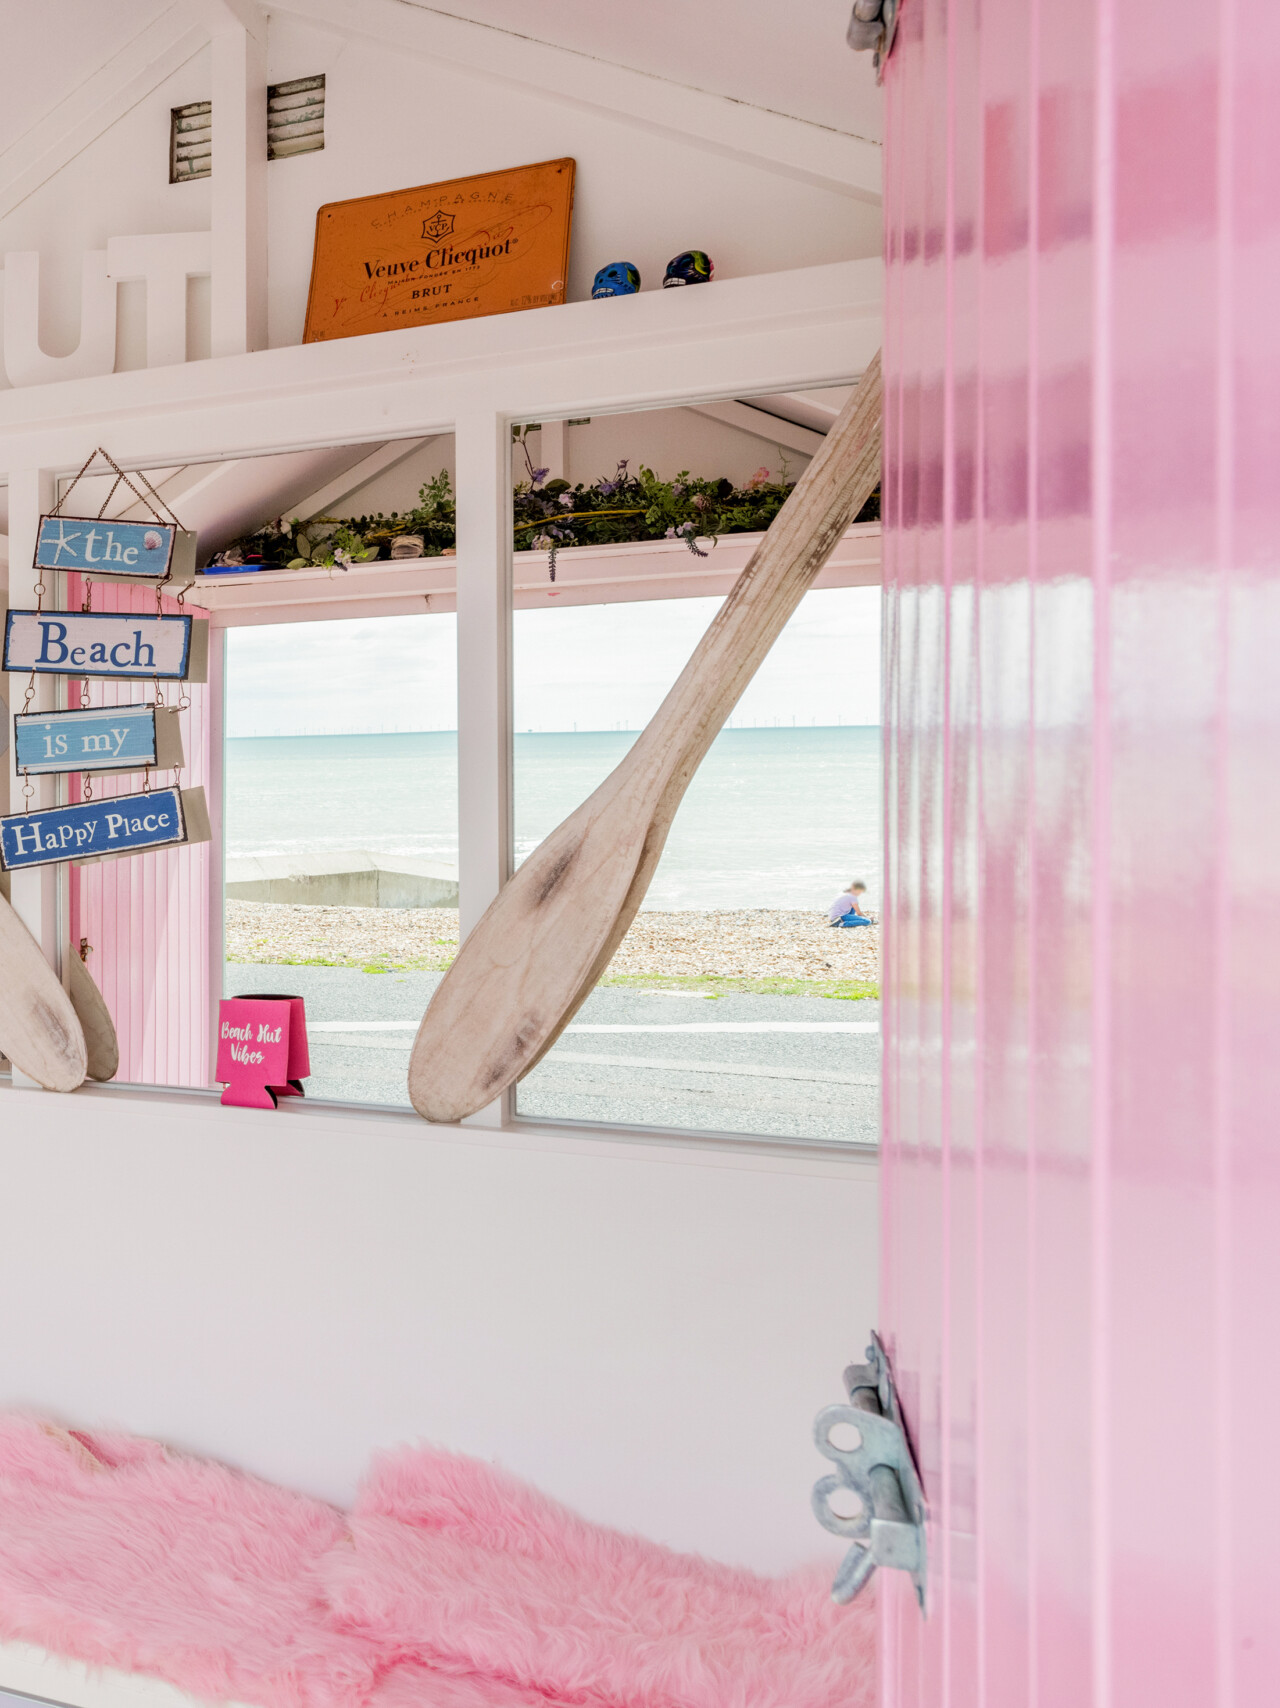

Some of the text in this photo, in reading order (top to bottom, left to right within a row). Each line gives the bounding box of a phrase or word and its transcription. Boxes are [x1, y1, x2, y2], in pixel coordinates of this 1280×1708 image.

[370, 192, 514, 228] CHAMPAGNE
[363, 258, 419, 280] Veuve
[411, 283, 453, 299] BRUT
[394, 305, 428, 316] REIMS
[435, 296, 479, 309] FRANCE
[85, 528, 139, 566] the
[35, 621, 157, 668] Beach
[43, 724, 130, 758] is my
[11, 809, 171, 856] Happy Place
[221, 1021, 282, 1043] Beach Hut
[231, 1042, 265, 1065] Vibes
